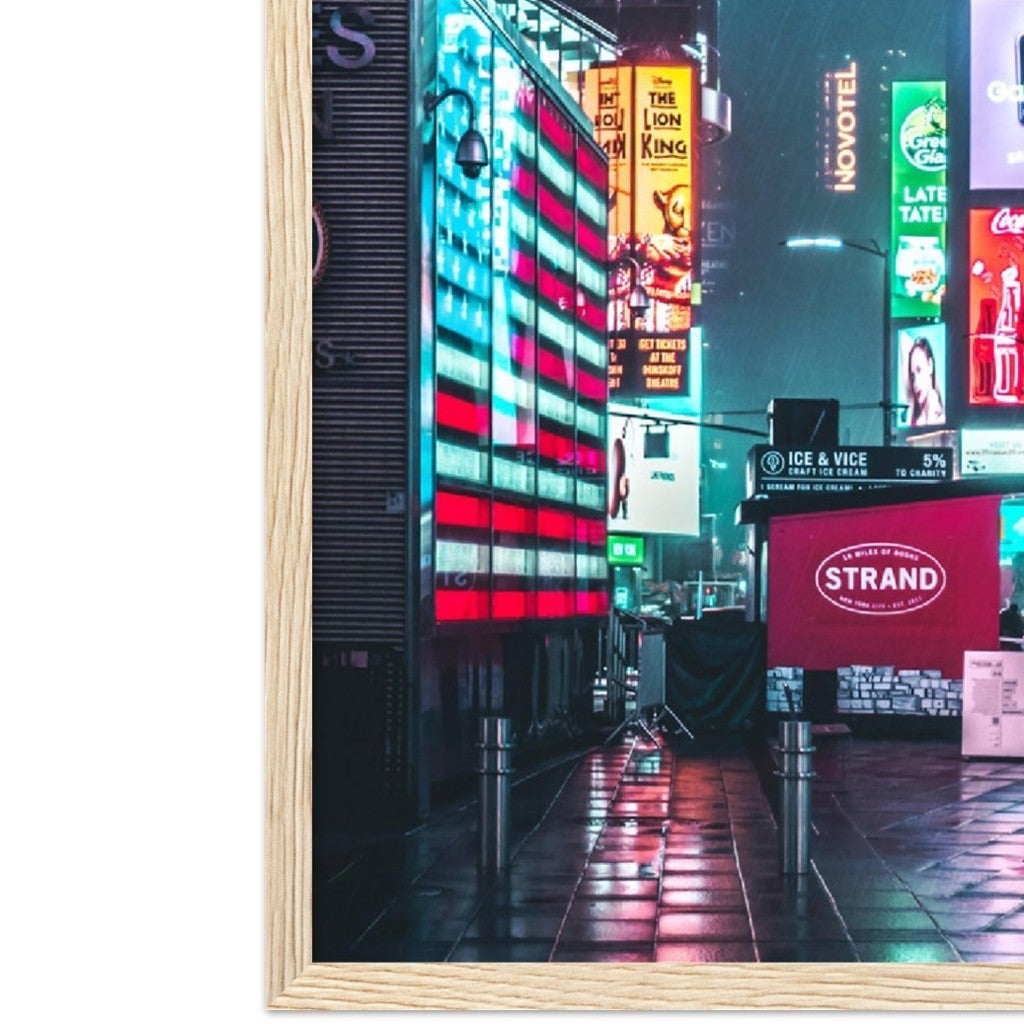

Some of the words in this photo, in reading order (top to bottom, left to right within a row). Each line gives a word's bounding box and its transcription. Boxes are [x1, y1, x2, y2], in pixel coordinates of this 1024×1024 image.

[648, 91, 676, 105] THE
[644, 108, 682, 131] LION
[834, 61, 857, 191] NOVOTEL
[641, 133, 687, 159] KING
[639, 339, 654, 350] GET
[650, 352, 660, 363] AT
[662, 352, 676, 363] THE
[789, 451, 812, 466] ICE
[818, 452, 829, 466] &
[833, 451, 867, 466] VICE
[923, 454, 946, 468] 5%
[788, 468, 816, 476] CRAFT
[820, 468, 833, 476] ICE
[837, 468, 867, 476] CREAM
[910, 469, 946, 477] CHARITY
[881, 548, 891, 556] OF
[825, 567, 938, 590] STRAND
